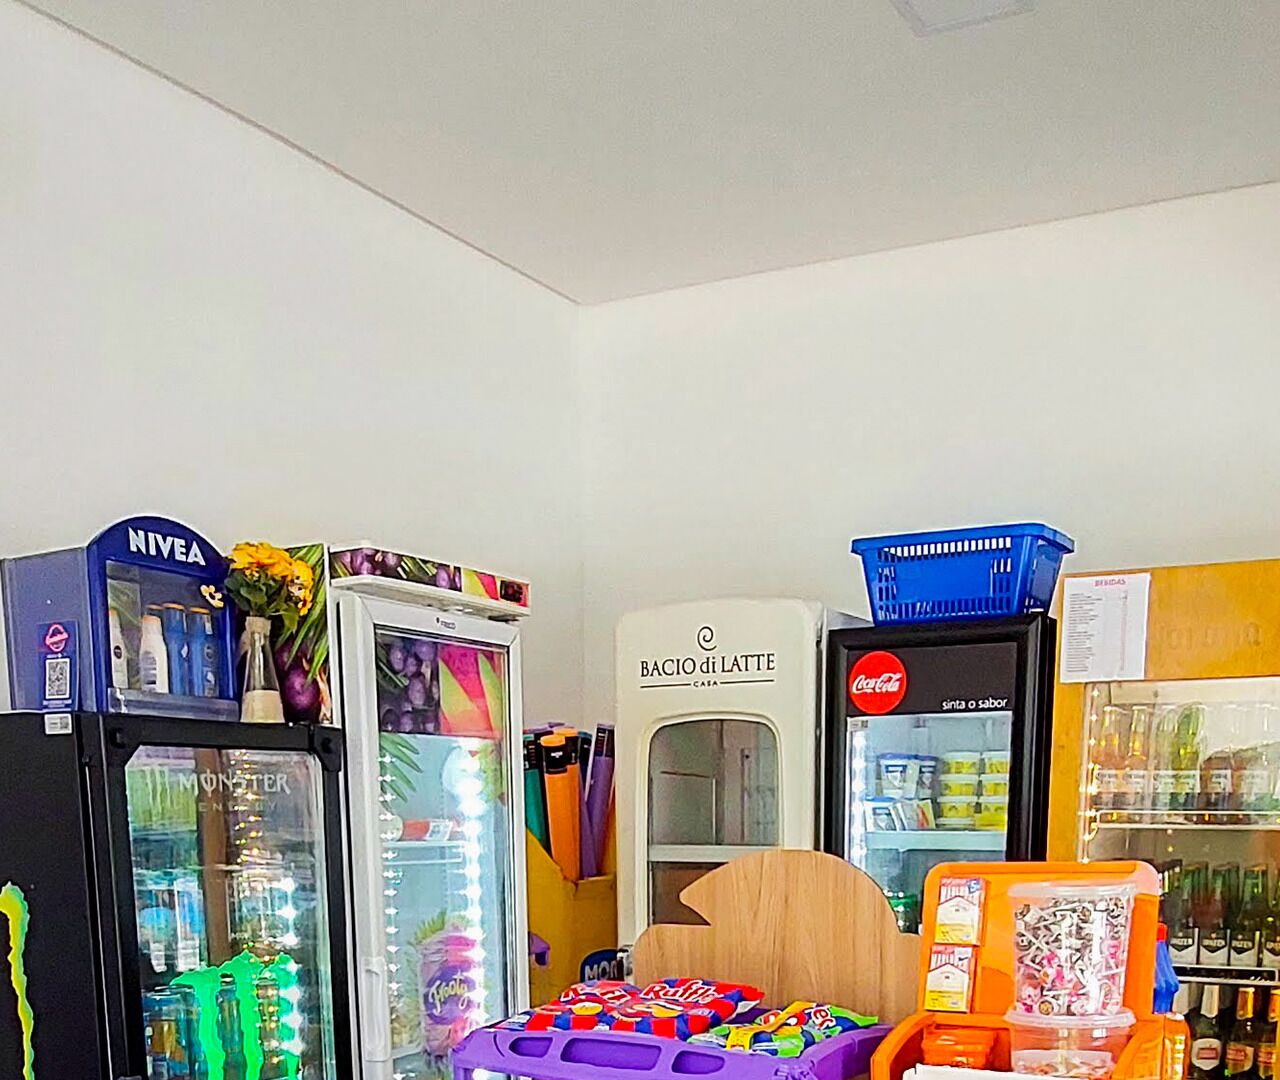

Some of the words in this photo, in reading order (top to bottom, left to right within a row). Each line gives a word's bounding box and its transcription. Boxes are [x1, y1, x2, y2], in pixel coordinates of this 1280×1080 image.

[127, 526, 206, 567] NIVEA
[640, 657, 696, 678] BACIO
[699, 656, 717, 674] di
[721, 652, 776, 673] LATTE
[693, 680, 718, 688] CASA
[942, 698, 966, 711] sinta
[967, 700, 977, 710] o
[978, 697, 1008, 709] sabor
[428, 969, 469, 1017] Frooty
